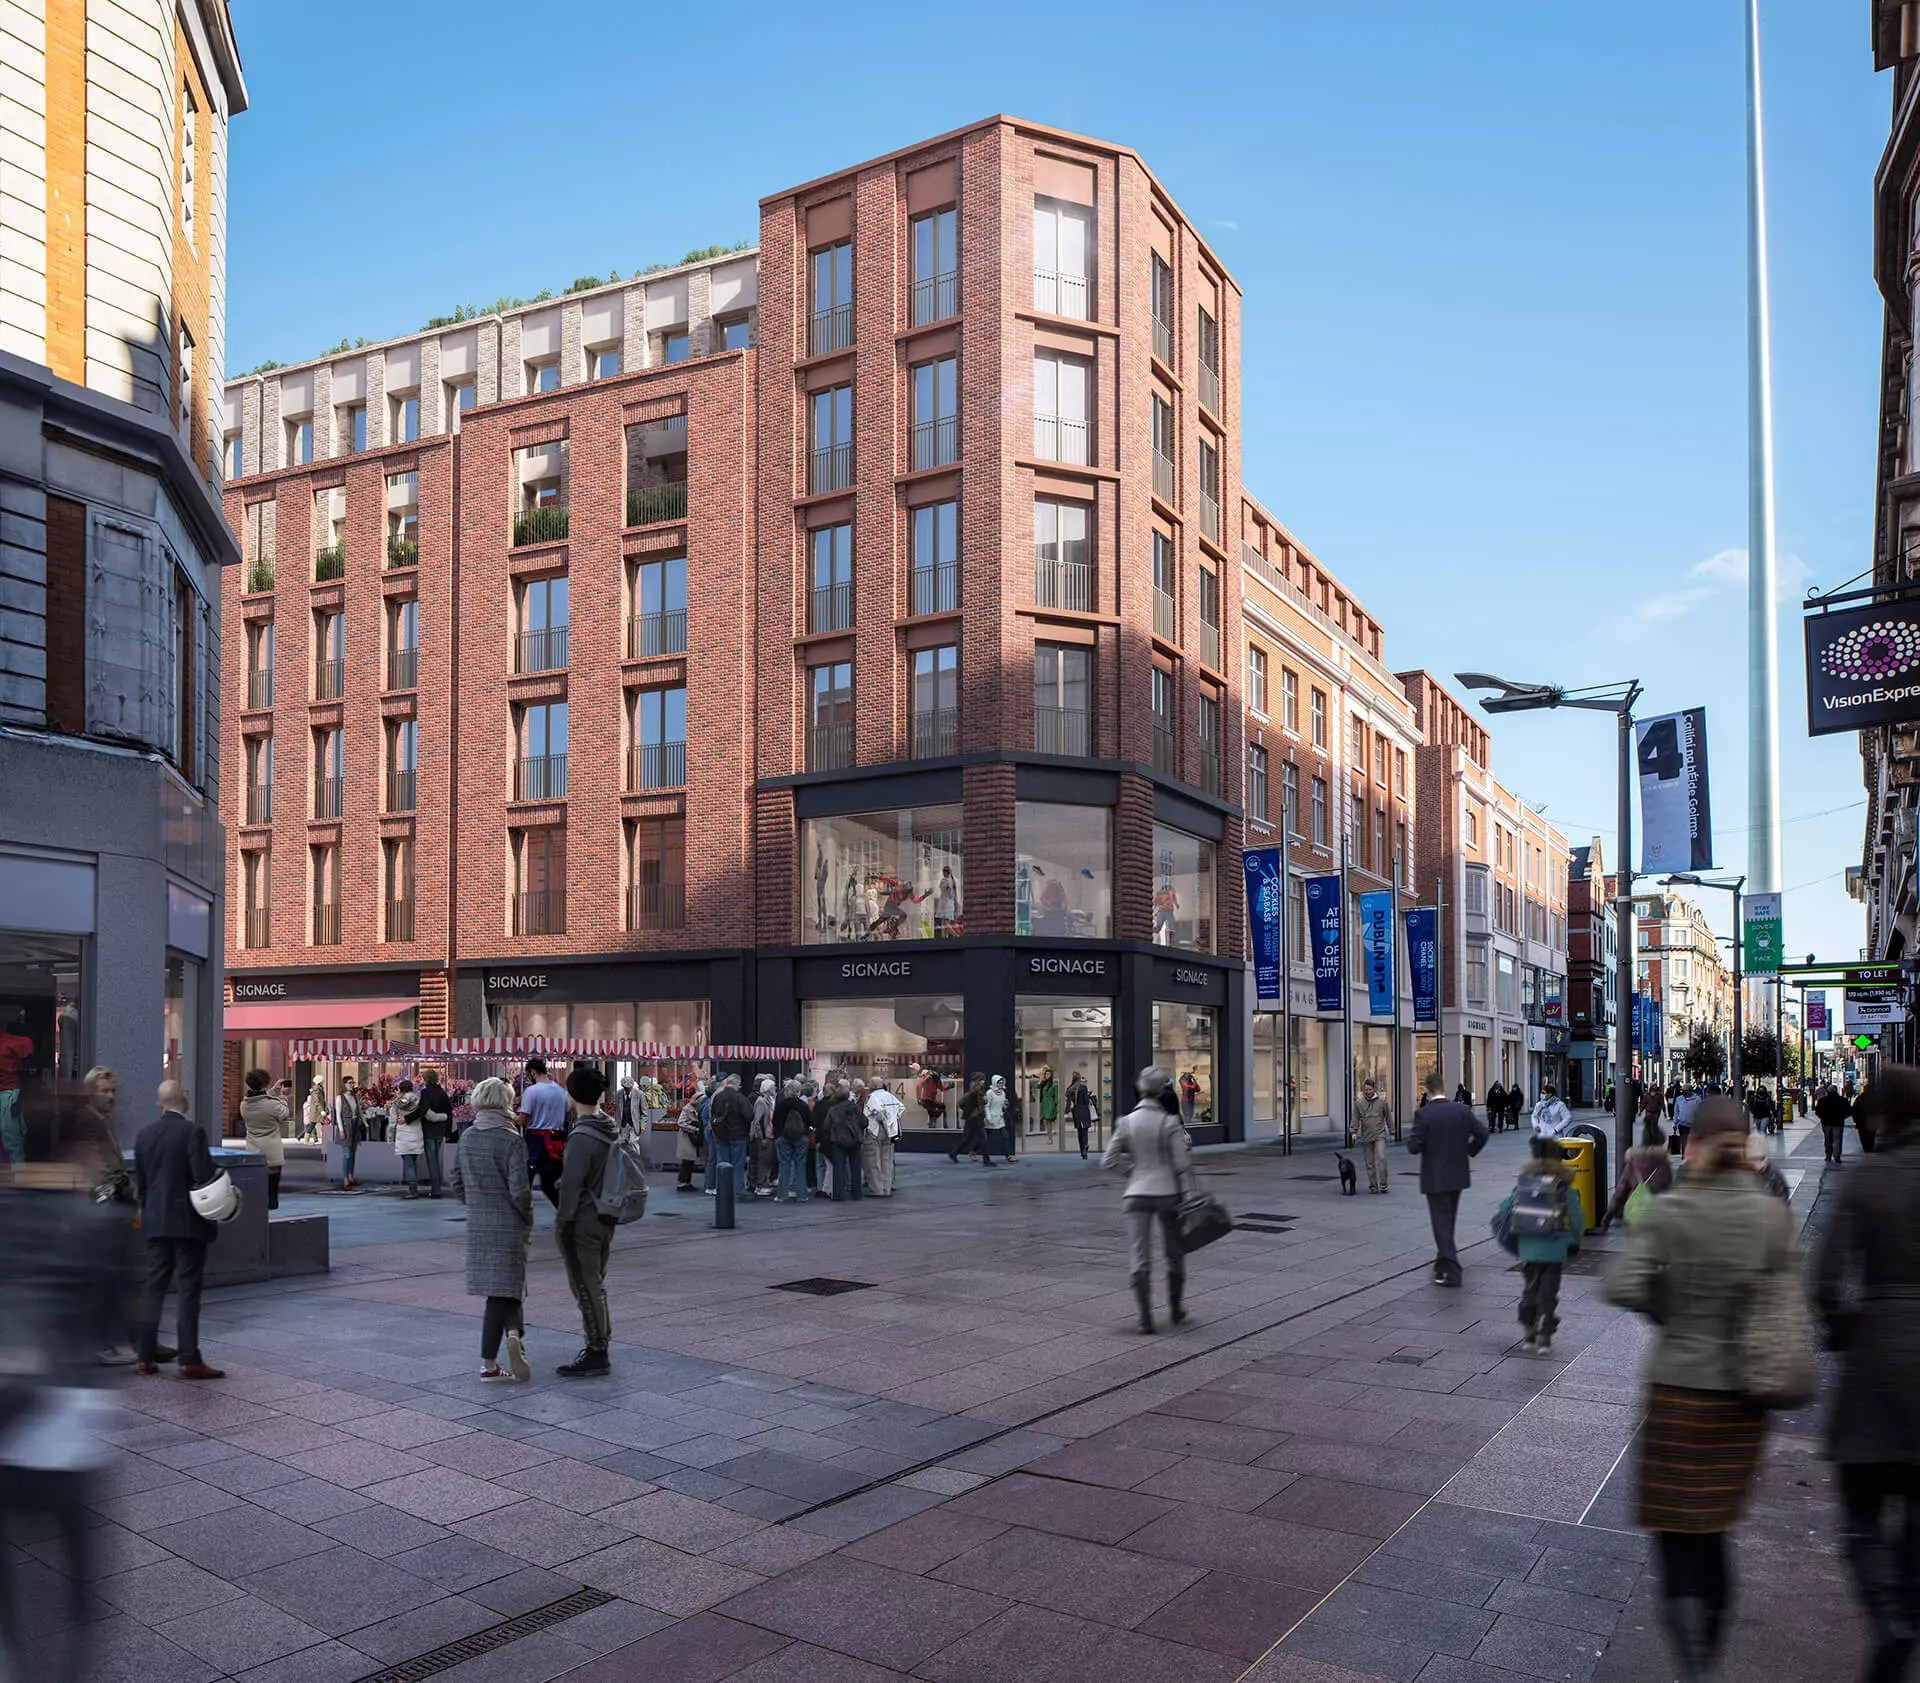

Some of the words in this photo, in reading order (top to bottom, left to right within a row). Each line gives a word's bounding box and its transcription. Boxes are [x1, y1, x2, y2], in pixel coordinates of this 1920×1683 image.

[1683, 714, 1696, 748] Cailíní
[1638, 717, 1683, 781] 4
[1685, 749, 1694, 763] na
[1688, 798, 1699, 839] Goirme
[1263, 886, 1271, 922] SEABASS
[1271, 877, 1279, 916] COCKLES
[1326, 907, 1339, 917] AT
[1321, 918, 1339, 928] THE
[1373, 910, 1385, 961] DUBLIN
[1324, 945, 1339, 955] OF
[1030, 957, 1105, 974] SIGNAGE
[1321, 956, 1339, 966] THE
[841, 961, 911, 978] SIGNAGE
[1176, 968, 1209, 986] SIGNAGE
[1316, 967, 1339, 978] CITY
[1858, 970, 1871, 979] TO
[1873, 969, 1889, 978] LET
[236, 983, 287, 996] SIGNAGE
[489, 974, 548, 989] SIGNAGE
